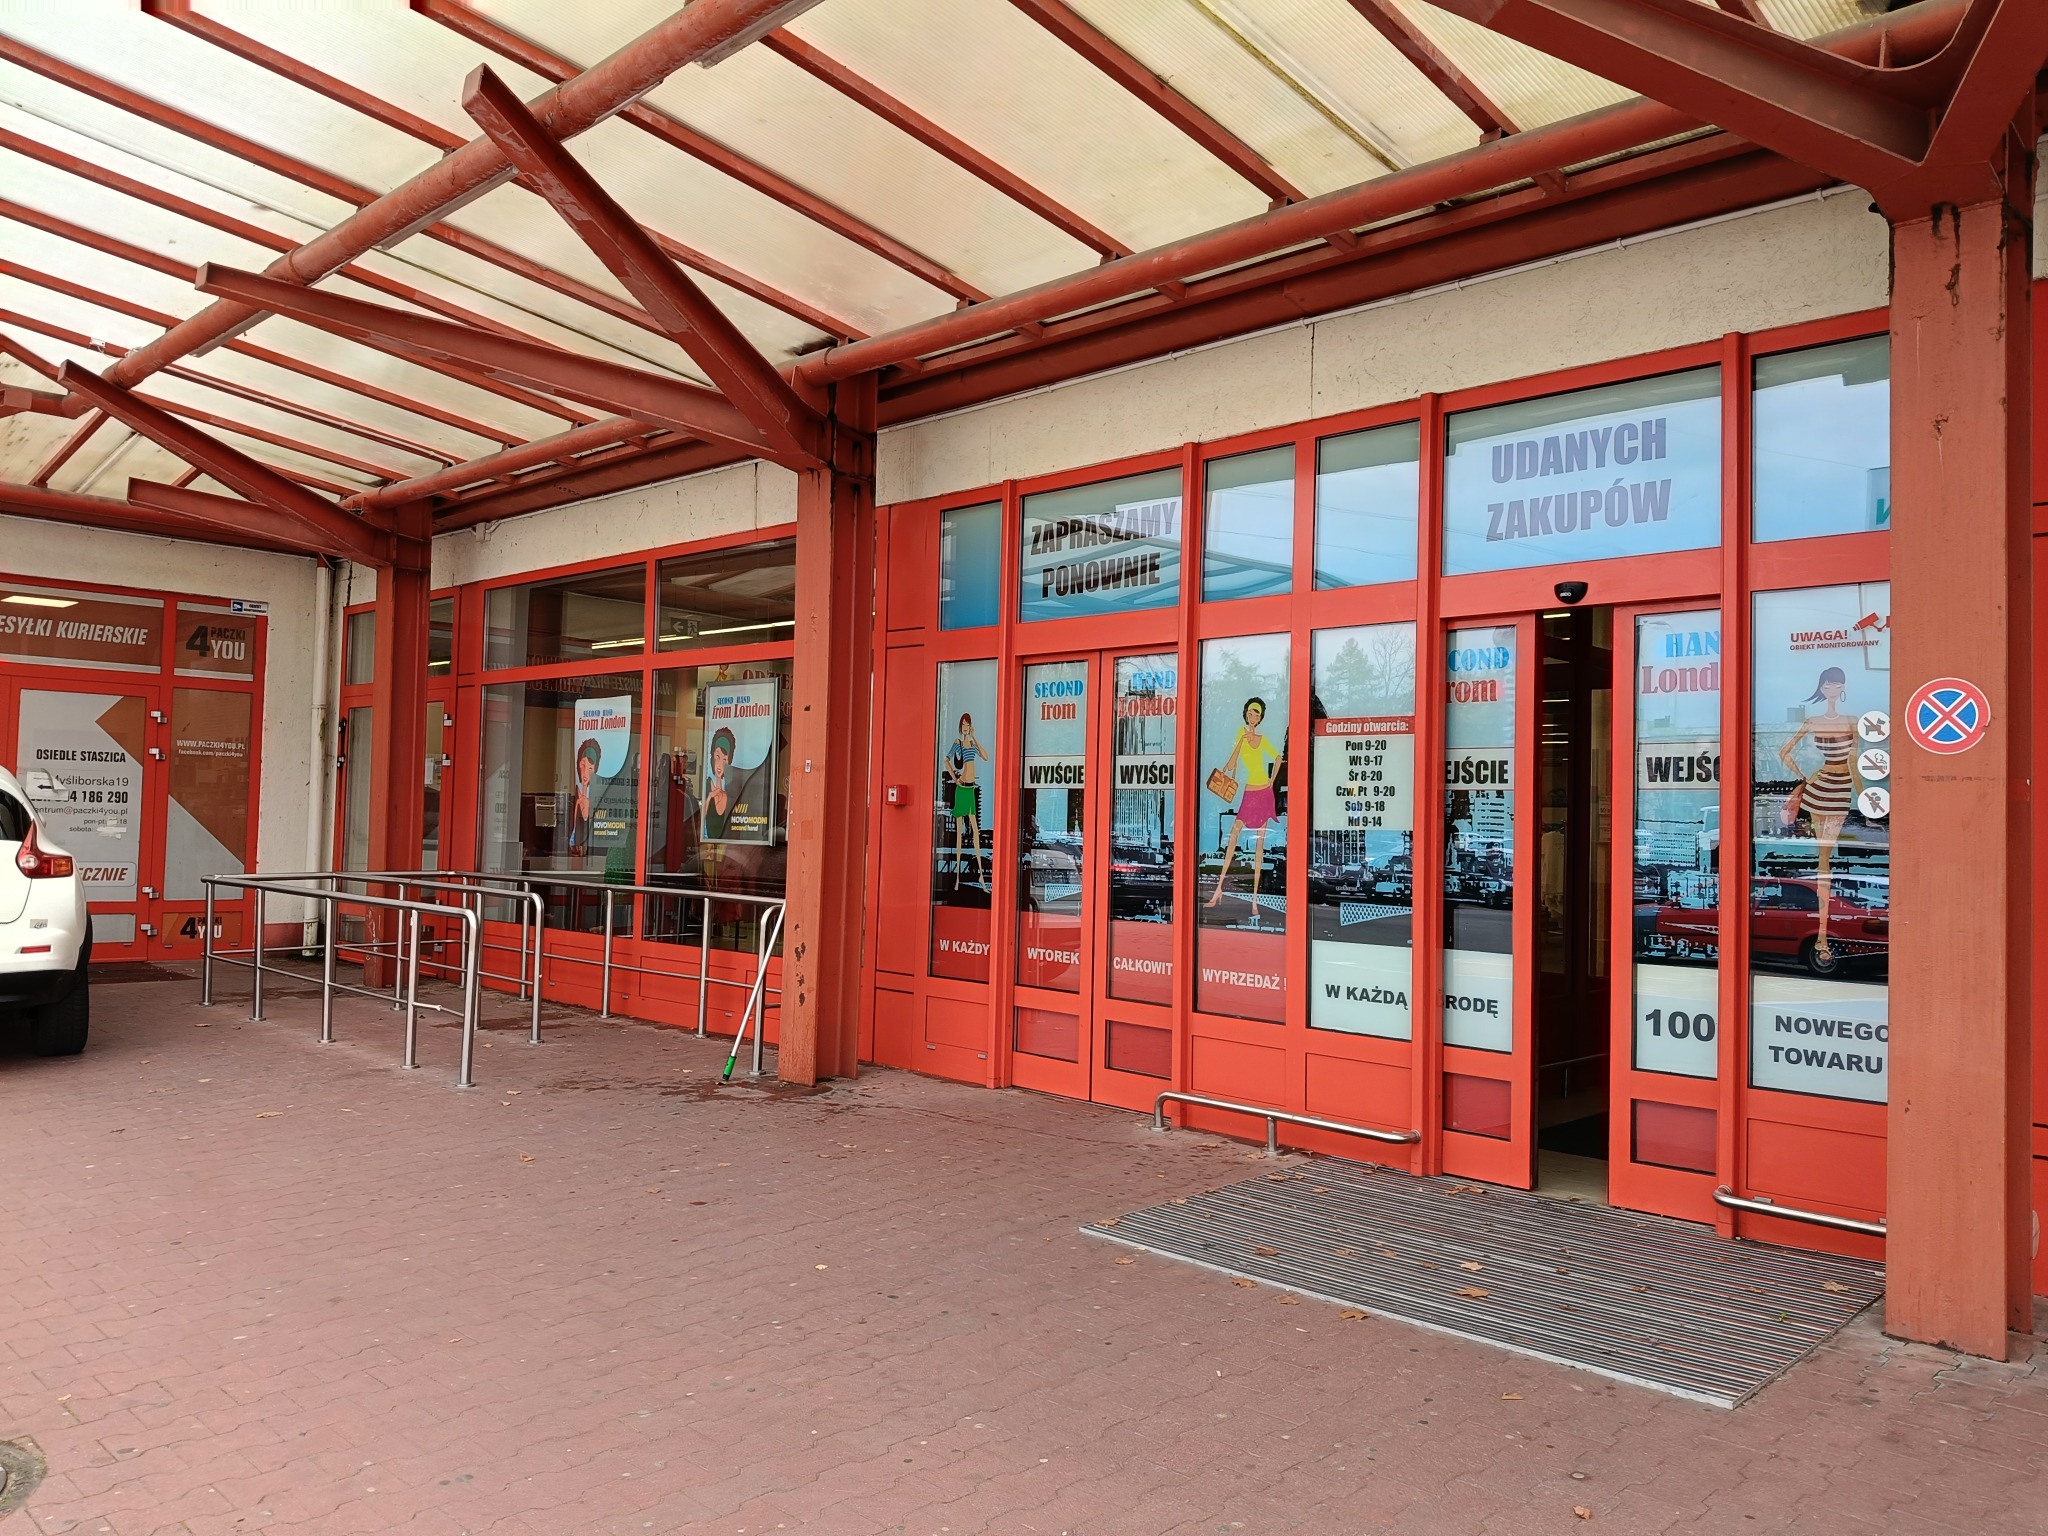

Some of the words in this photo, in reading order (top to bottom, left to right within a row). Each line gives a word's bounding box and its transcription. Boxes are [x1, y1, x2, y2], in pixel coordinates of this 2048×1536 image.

[1491, 417, 1667, 484] UDANYCH
[1486, 477, 1672, 543] ZAKUPÓW
[1031, 501, 1177, 555] ZAPRASZAMY
[1042, 552, 1161, 598] PONOWNIE
[56, 620, 149, 646] KURIERSKIE
[185, 625, 210, 657] 4
[210, 626, 246, 640] PACZKI
[1790, 629, 1848, 643] UWAGA!
[210, 639, 245, 660] YOU
[1789, 643, 1815, 651] OBIEKT
[1816, 639, 1880, 650] MONITOROWANY
[1447, 646, 1510, 673] COND
[1641, 662, 1720, 694] Lond
[1034, 680, 1084, 699] SECOND
[711, 706, 732, 719] from
[733, 702, 771, 718] London
[717, 697, 734, 705] SECOND
[1040, 701, 1077, 720] from
[1118, 694, 1177, 717] Londo
[578, 717, 599, 731] from
[600, 715, 626, 730] London
[1325, 721, 1362, 734] Godziny
[1363, 719, 1409, 732] otwarcia:
[177, 739, 246, 750] WWW.PACZKI4YOU.PL
[1345, 740, 1363, 751] Pon
[1365, 739, 1387, 750] 9-20
[36, 749, 77, 761] OSIEDLE
[80, 751, 127, 763] STASZICA
[1349, 755, 1362, 766] Wt
[1364, 755, 1383, 766] 9-17
[1029, 762, 1084, 785] WYJŚCIE
[1348, 769, 1359, 781] Śr
[1360, 770, 1383, 781] 8-20
[82, 790, 103, 803] 186
[107, 791, 128, 804] 290
[1335, 785, 1356, 797] Czw,
[1357, 785, 1367, 796] Pt
[1373, 785, 1396, 797] 9-20
[1345, 801, 1363, 812] Sob
[1364, 801, 1385, 811] 9-18
[1348, 816, 1360, 826] Nd
[1362, 816, 1382, 826] 9-14
[181, 916, 197, 939] 4
[197, 925, 222, 939] YU
[939, 939, 950, 951] W
[952, 940, 990, 956] KAŻDY
[1027, 947, 1080, 965] WTOREK
[1112, 956, 1173, 976] CAŁKOWIT
[1202, 968, 1280, 991] WYPRZEDAŻ
[1325, 983, 1341, 998] W
[1346, 985, 1409, 1011] KAŻDĄ
[1443, 994, 1499, 1019] RODĘ
[1645, 1008, 1716, 1042] 100
[1775, 1014, 1889, 1043] NOWEGO
[1768, 1045, 1883, 1075] TOWARU
